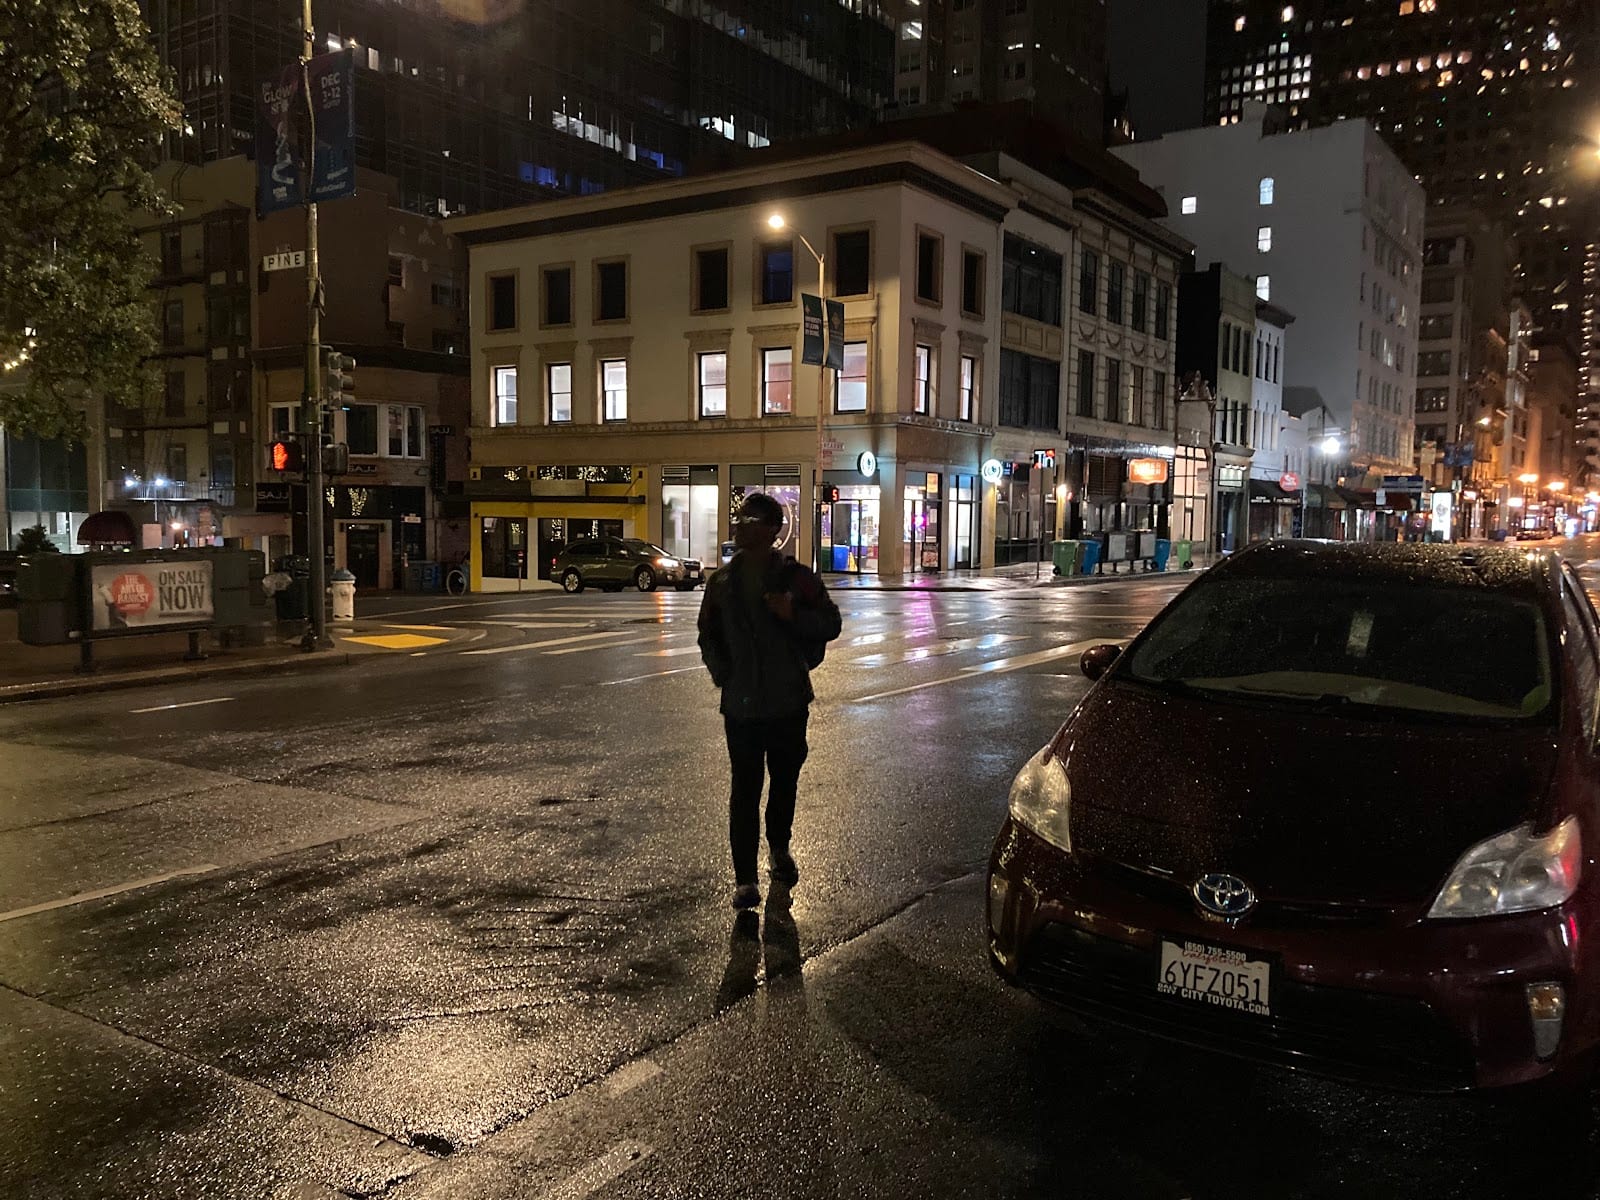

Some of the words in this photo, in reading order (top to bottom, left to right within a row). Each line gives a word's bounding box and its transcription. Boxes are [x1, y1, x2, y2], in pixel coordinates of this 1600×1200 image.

[321, 72, 341, 88] DEC
[268, 254, 300, 268] PINE
[257, 490, 289, 500] SAJJ
[125, 574, 139, 585] THE
[159, 571, 176, 586] ON
[178, 570, 205, 585] SALE
[159, 584, 205, 611] NOW
[1184, 941, 1205, 954] (650)
[1207, 946, 1247, 962] 755-5500
[1165, 960, 1261, 1004] 6YFZ051
[1181, 987, 1204, 1001] CITY
[1206, 992, 1270, 1017] TOYOTA.COM
